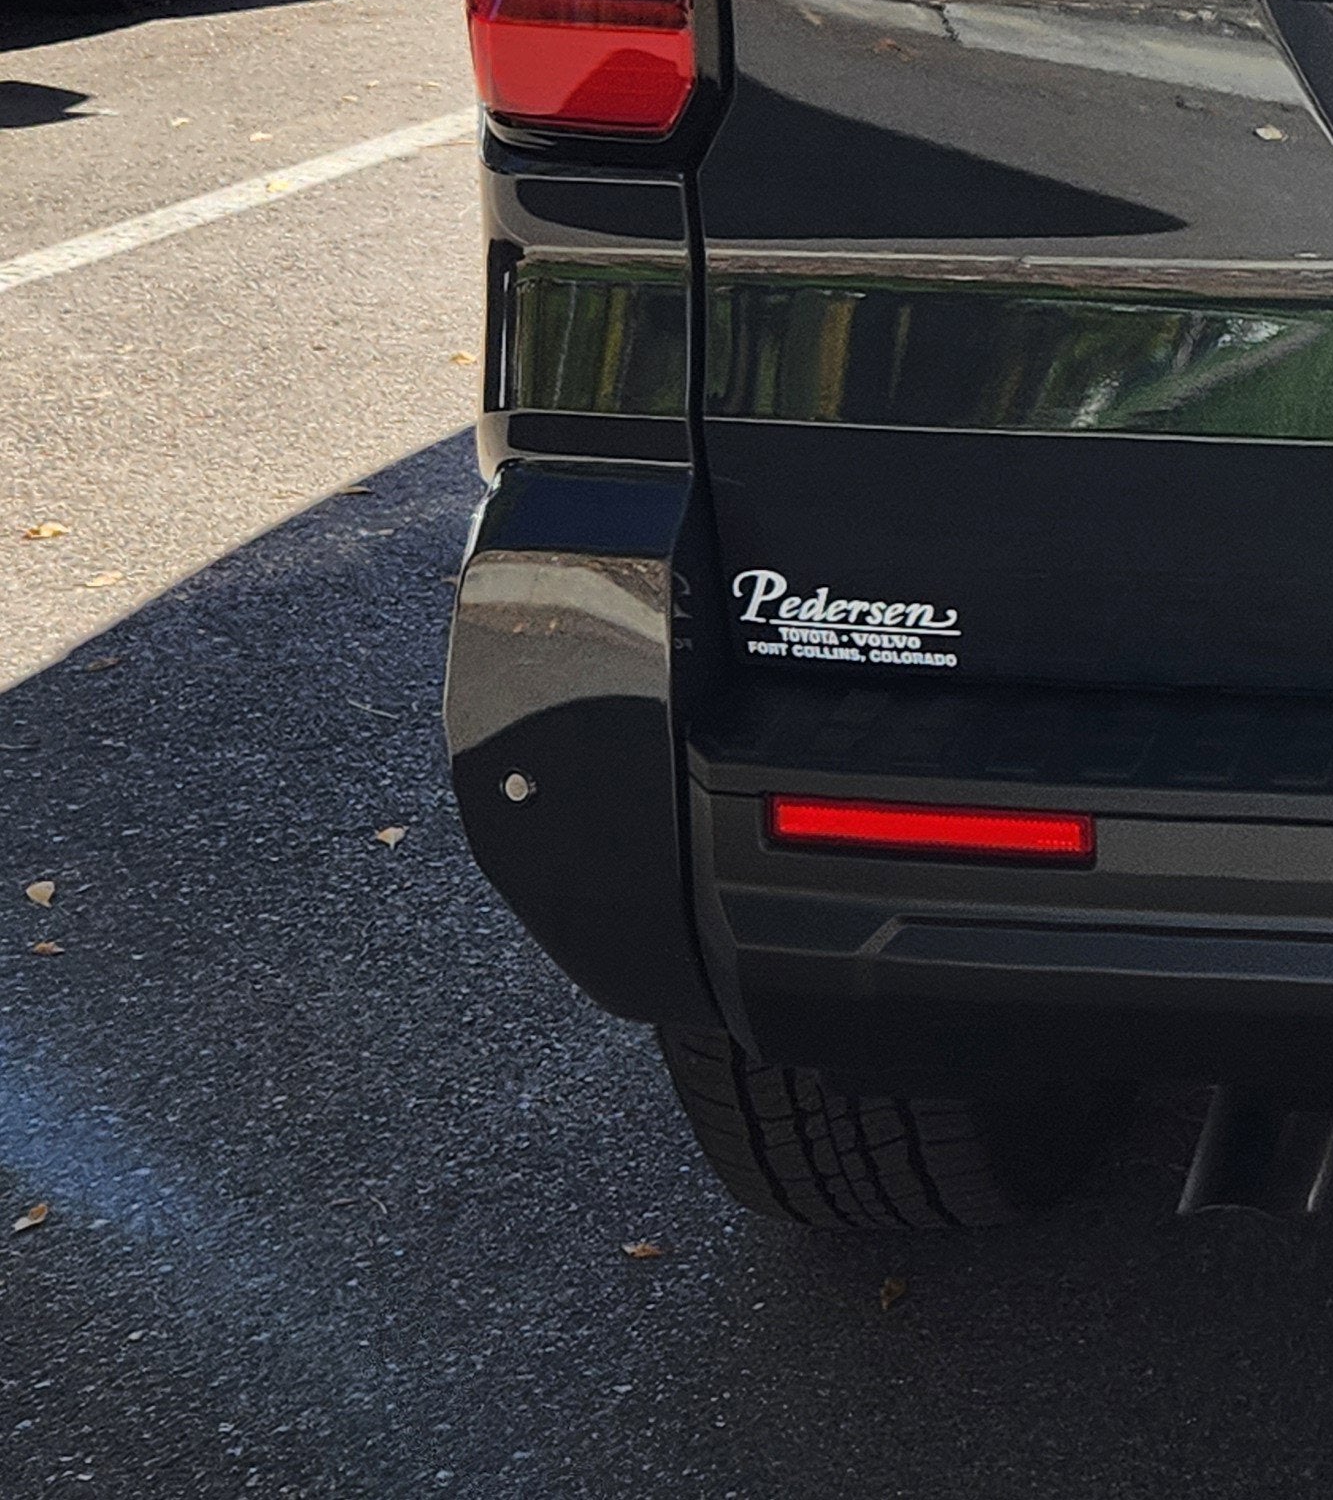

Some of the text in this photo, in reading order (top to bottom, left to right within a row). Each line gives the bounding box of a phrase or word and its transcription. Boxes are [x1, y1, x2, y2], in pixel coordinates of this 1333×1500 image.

[732, 569, 960, 630] Pedersen
[777, 626, 922, 650] TOYOTA VOLVO
[747, 640, 789, 657] FORT
[868, 649, 958, 668] COLORADO
